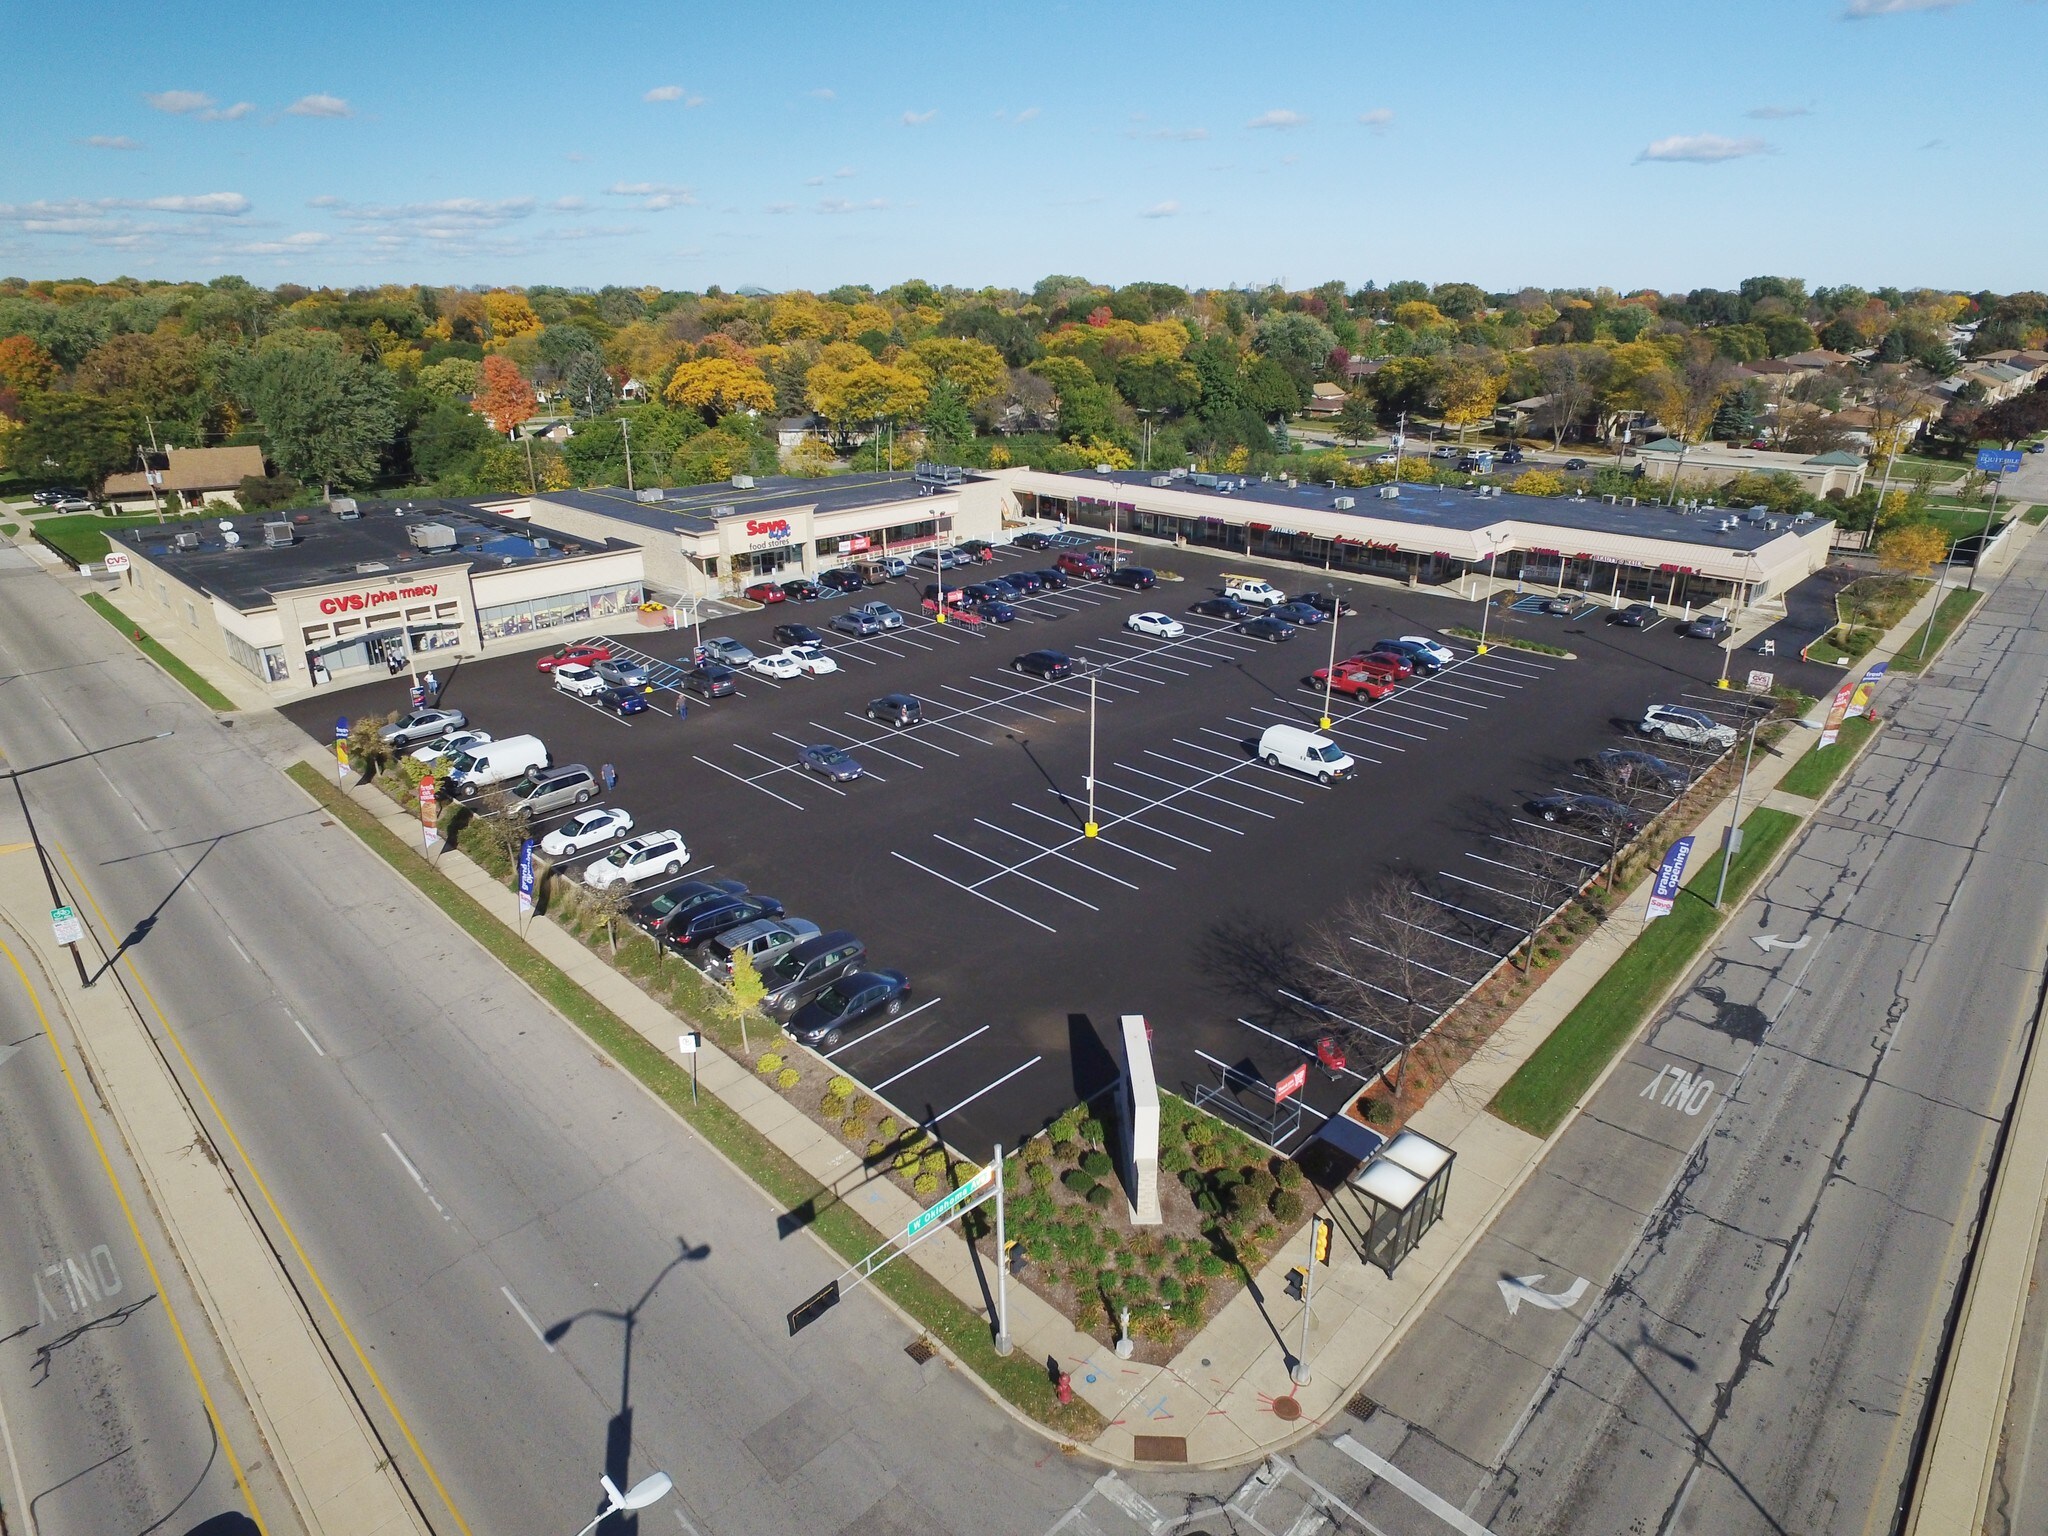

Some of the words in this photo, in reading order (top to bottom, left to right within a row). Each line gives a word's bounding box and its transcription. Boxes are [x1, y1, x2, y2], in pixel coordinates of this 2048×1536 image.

[746, 519, 787, 536] Save
[749, 541, 767, 551] food
[768, 538, 790, 548] stores
[107, 556, 128, 564] CVS
[520, 863, 529, 892] grand
[1668, 841, 1690, 888] opening!
[1657, 864, 1674, 896] grand
[1651, 899, 1672, 909] Save
[1640, 1063, 1715, 1116] ONLY
[912, 1218, 922, 1231] W
[924, 1188, 968, 1221] Oklahoma
[32, 1244, 123, 1326] ONLY
